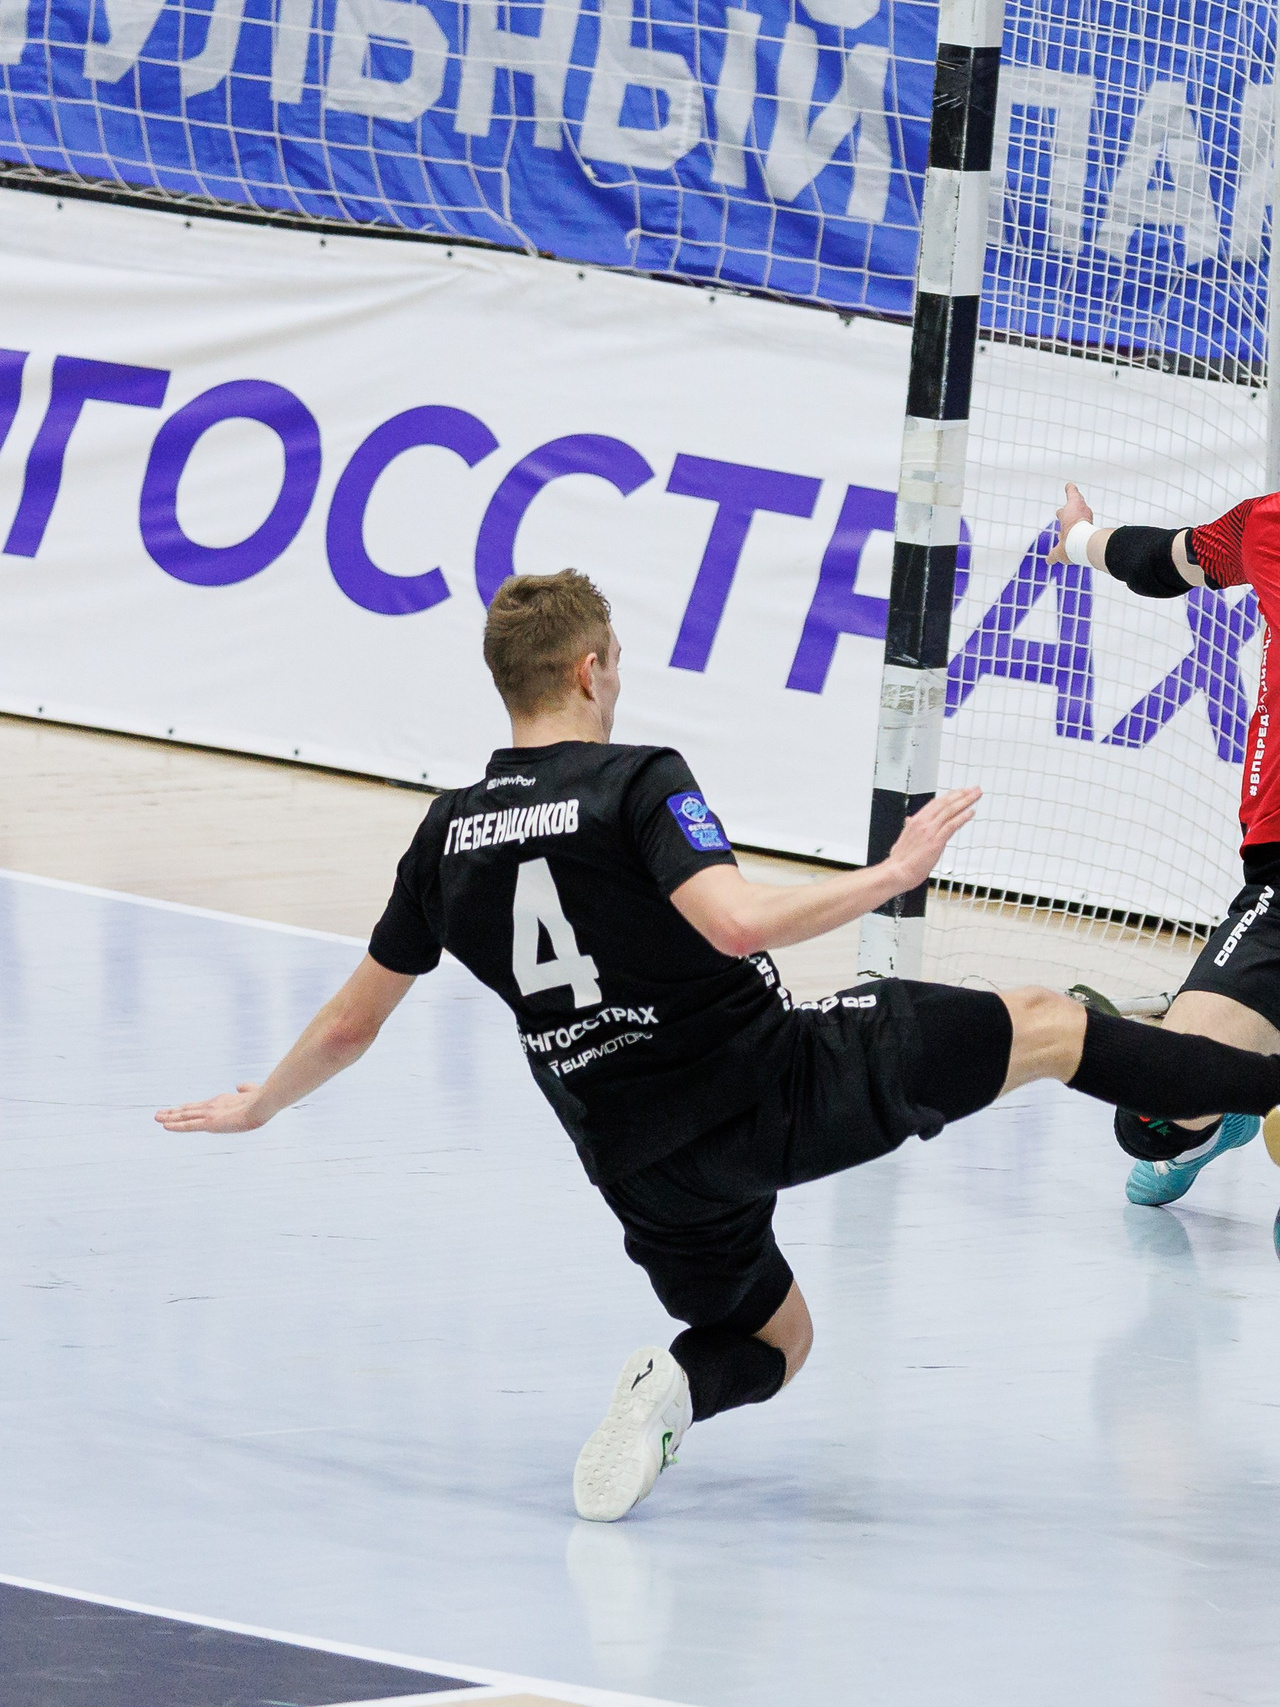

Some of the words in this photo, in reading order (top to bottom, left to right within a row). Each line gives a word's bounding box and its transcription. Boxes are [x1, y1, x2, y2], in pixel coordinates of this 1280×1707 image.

[0, 348, 1263, 764] ГОССТРАХ
[512, 857, 603, 1008] 4
[526, 1005, 660, 1053] НГОССТРАХ
